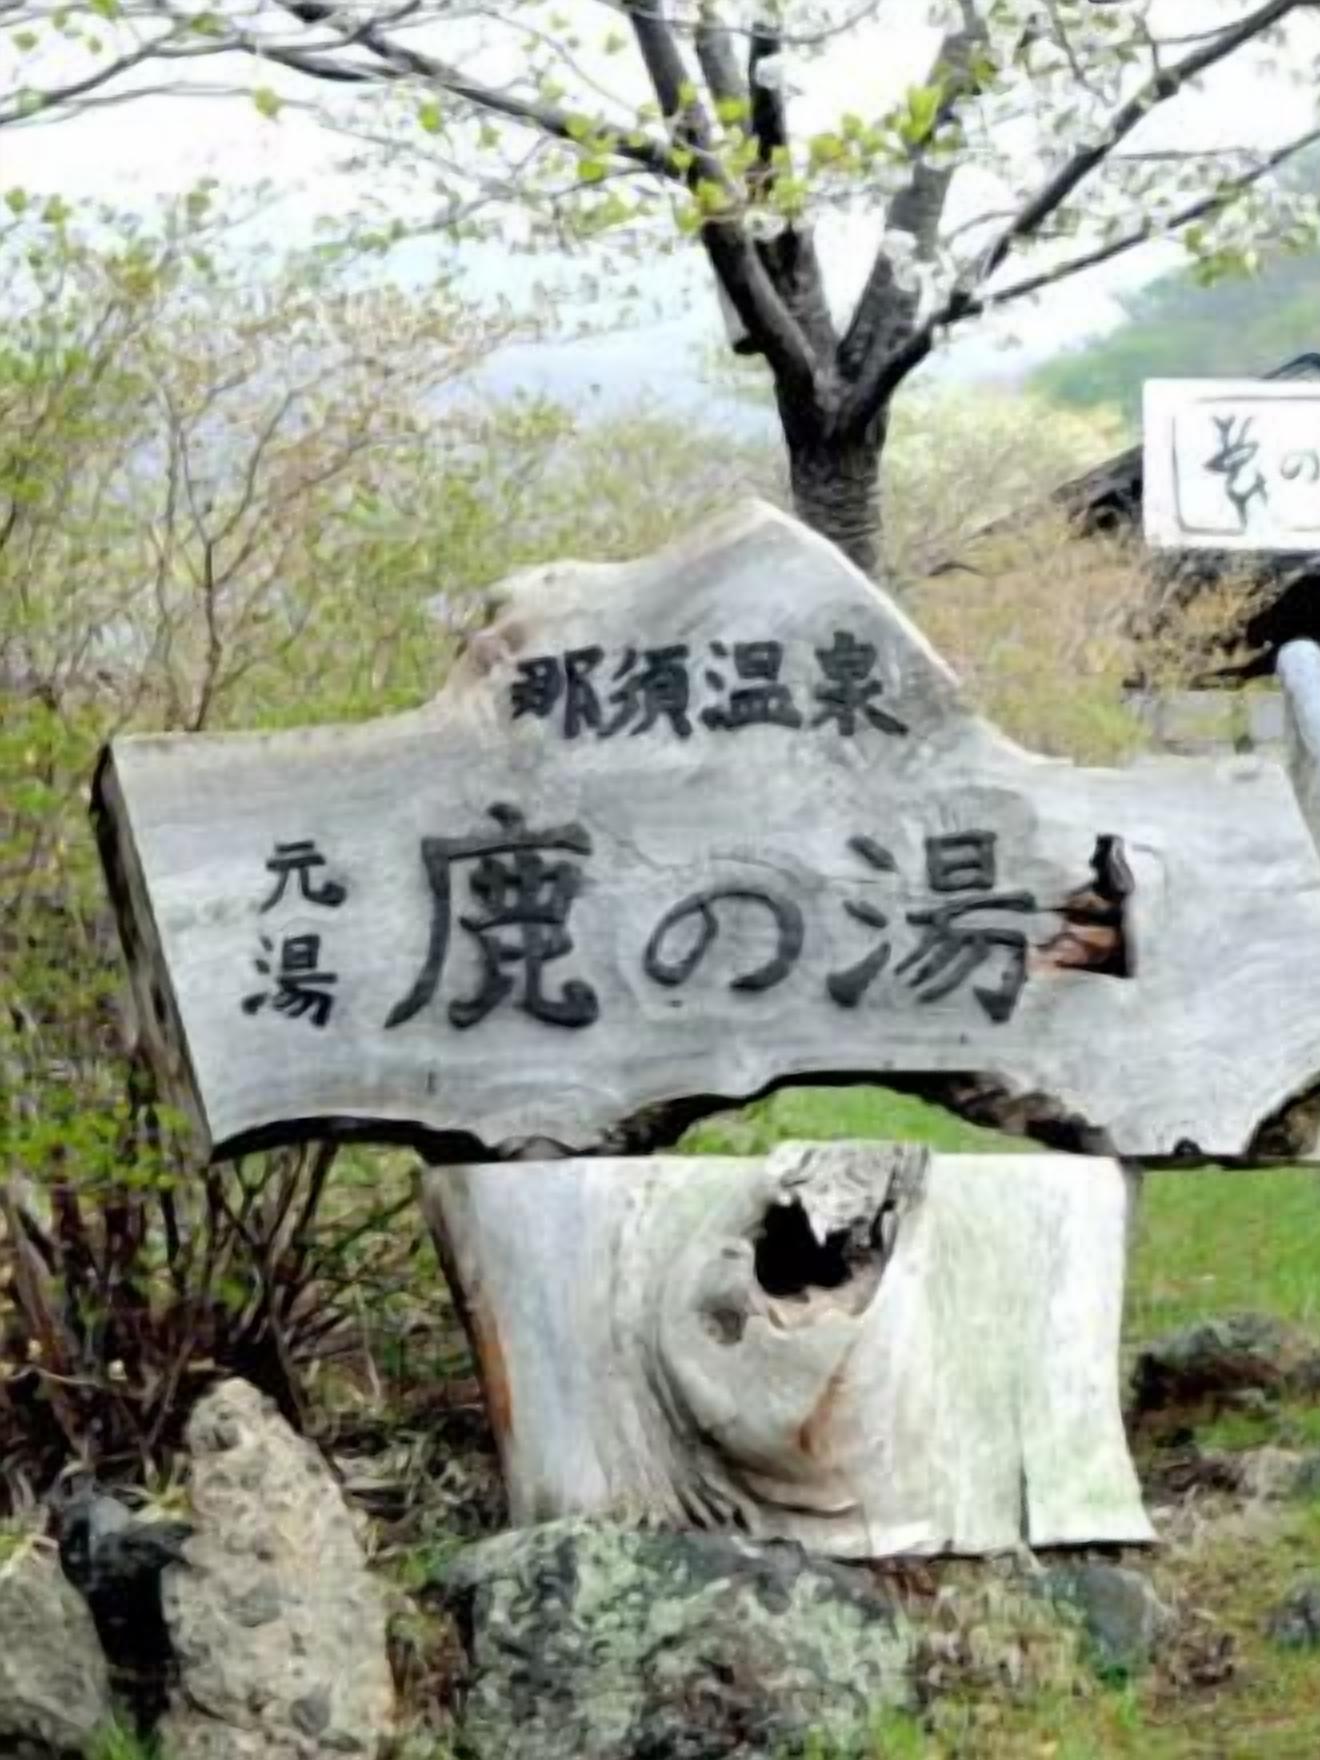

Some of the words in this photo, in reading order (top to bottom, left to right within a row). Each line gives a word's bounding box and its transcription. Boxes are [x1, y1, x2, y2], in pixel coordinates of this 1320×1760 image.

[509, 631, 909, 739] 那須温泉
[241, 840, 347, 1028] 元湯
[384, 803, 1036, 1029] 鹿の湯
